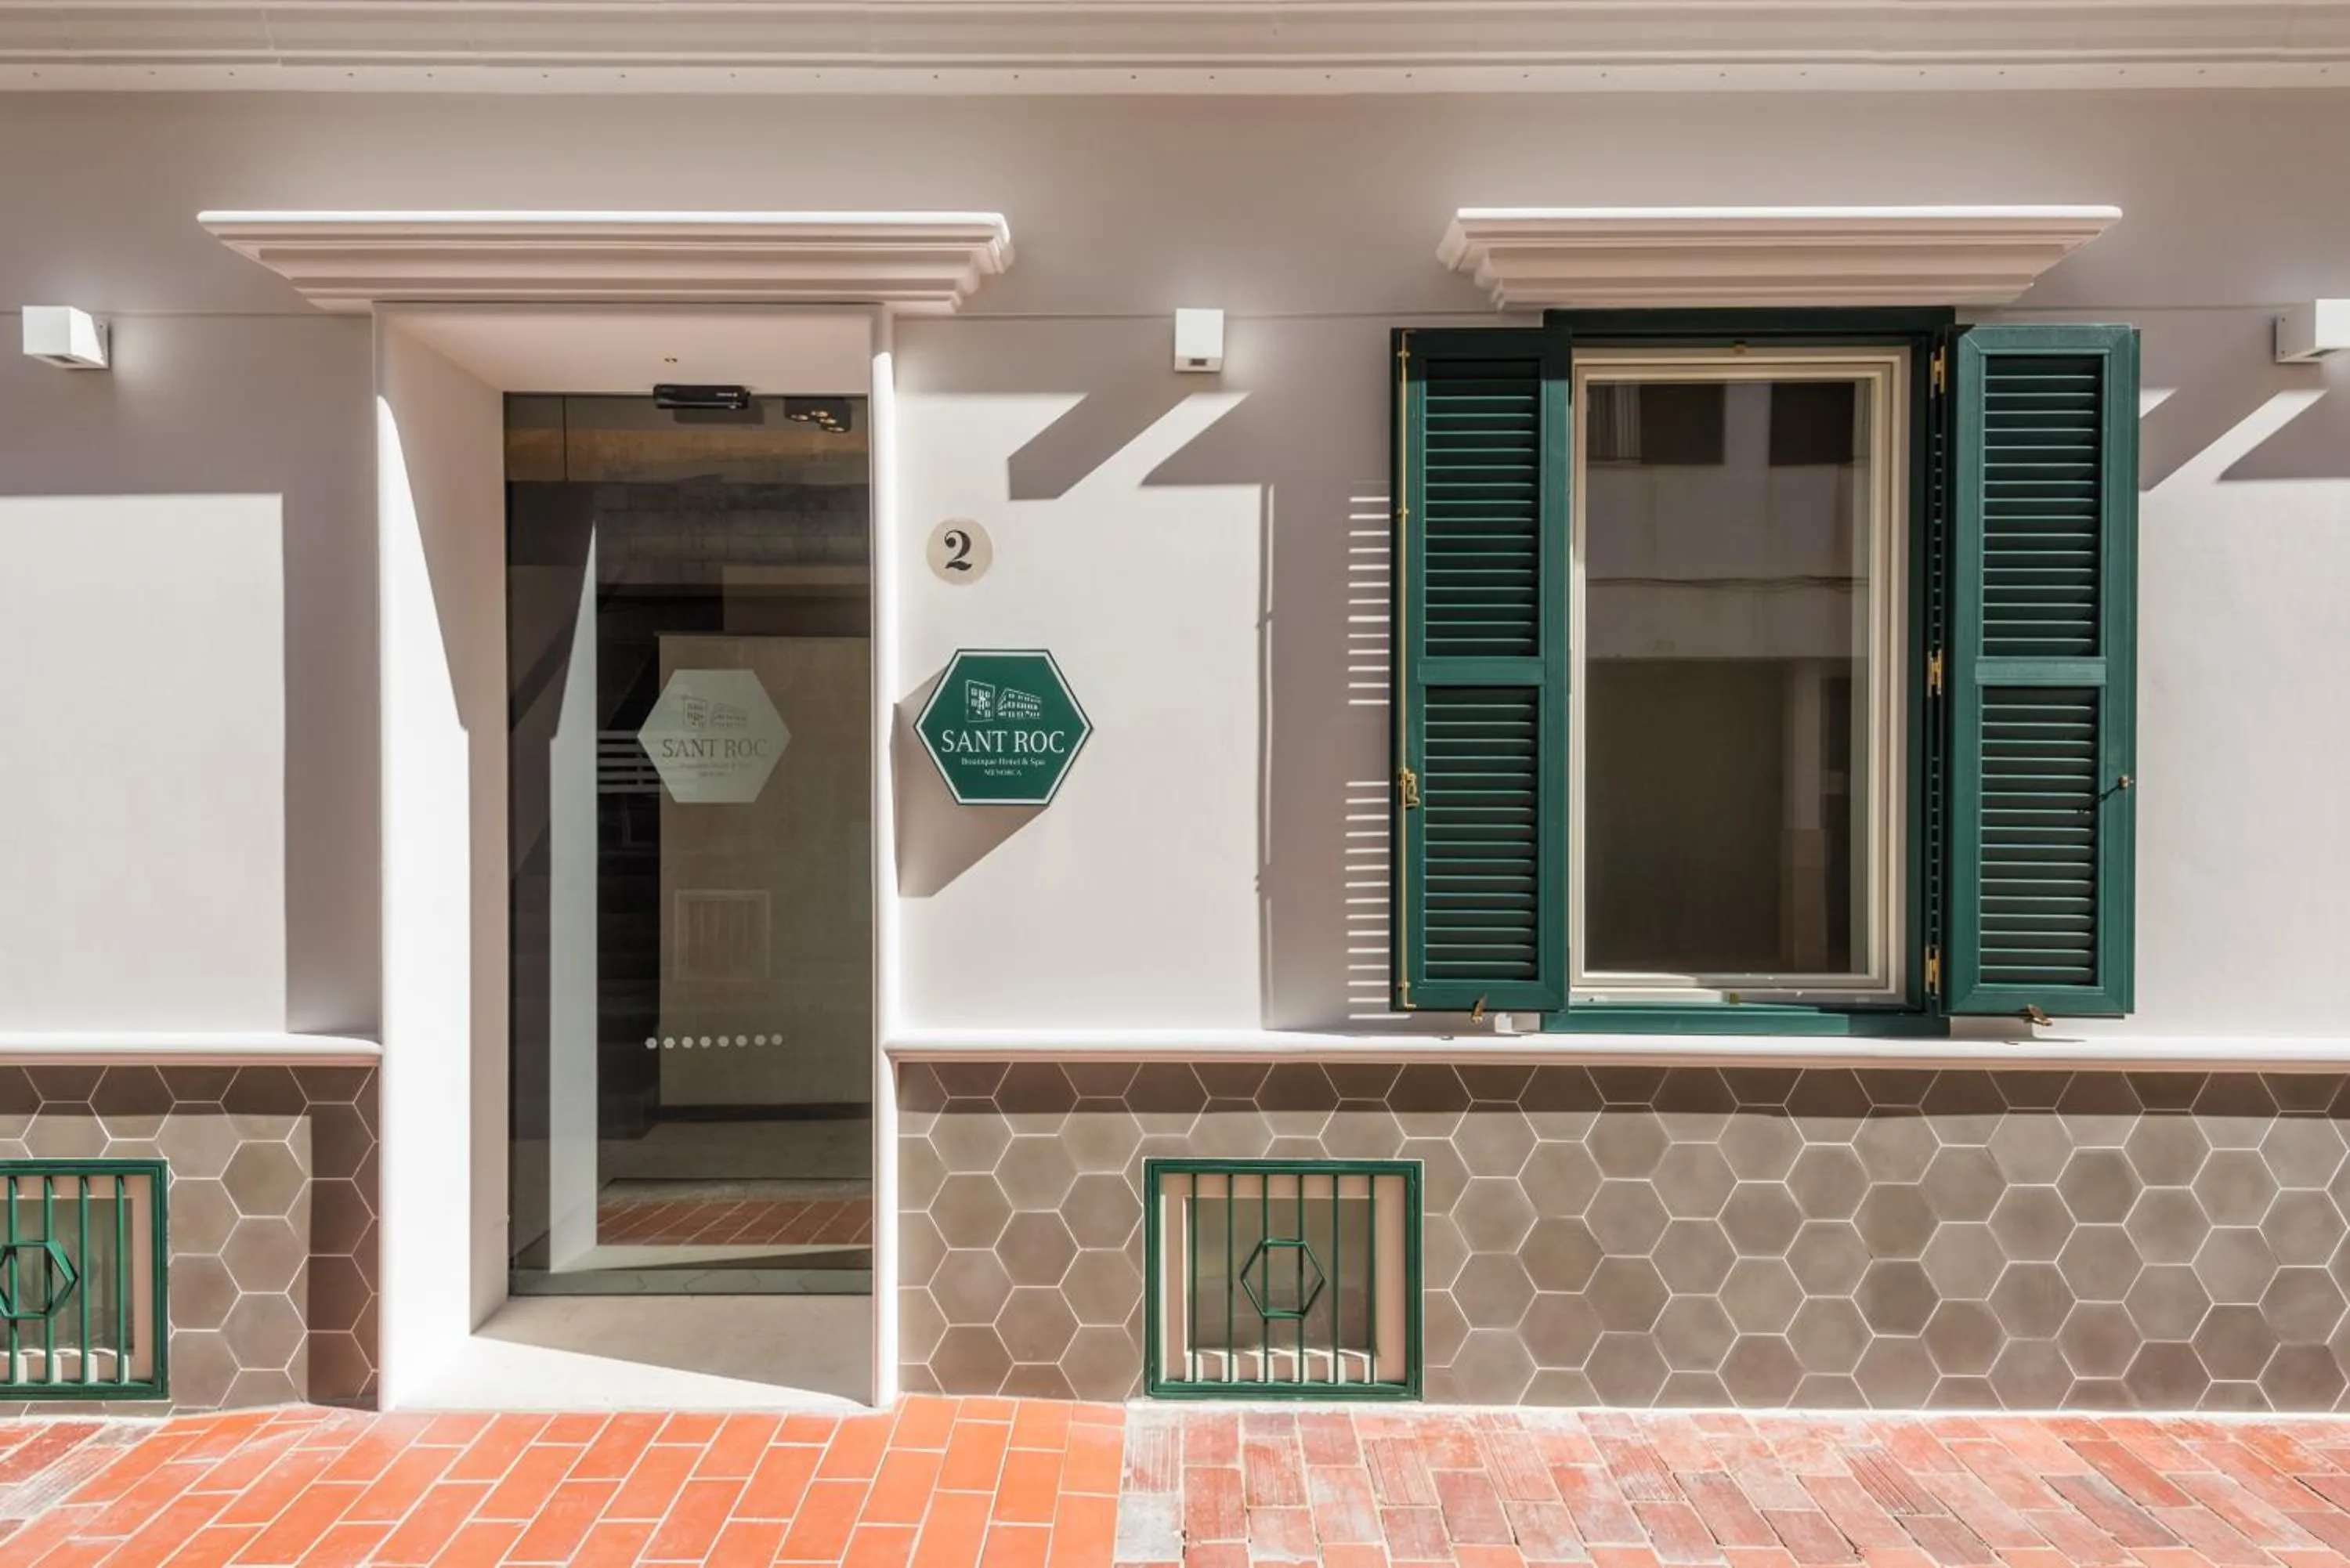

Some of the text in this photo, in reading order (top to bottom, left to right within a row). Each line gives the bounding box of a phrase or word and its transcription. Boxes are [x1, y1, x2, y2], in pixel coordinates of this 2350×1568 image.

[944, 529, 973, 571] 2
[662, 739, 768, 758] SANT ROC
[941, 729, 1065, 753] SANT ROC
[1030, 757, 1046, 768] Spa
